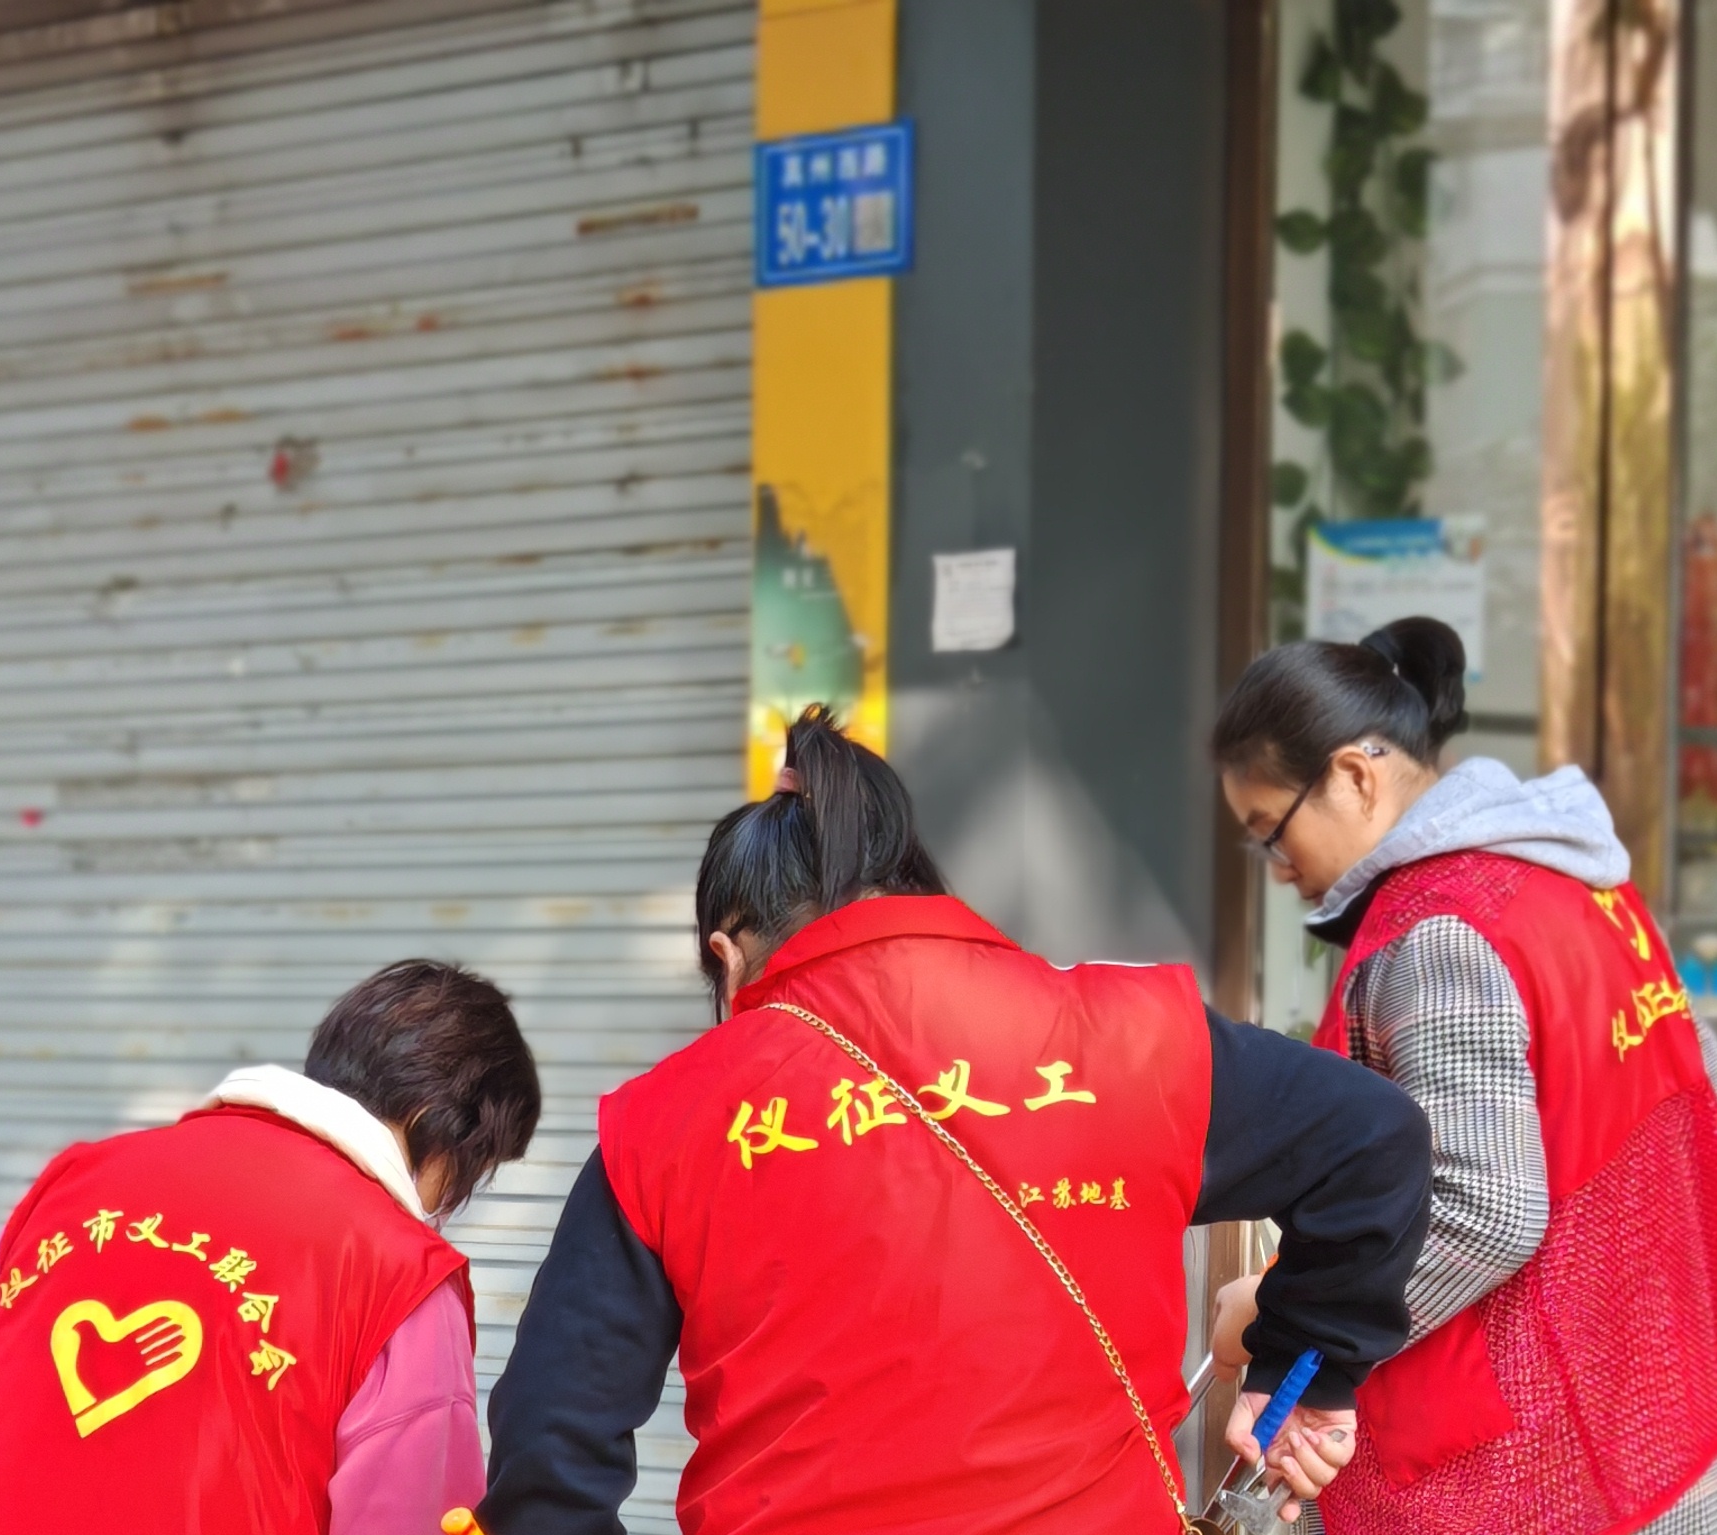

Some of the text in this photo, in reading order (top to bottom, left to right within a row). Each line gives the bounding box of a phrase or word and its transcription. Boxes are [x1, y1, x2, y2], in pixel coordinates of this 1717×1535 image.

[727, 1058, 1097, 1170] 仪征义工
[1017, 1176, 1131, 1210] 江苏地基
